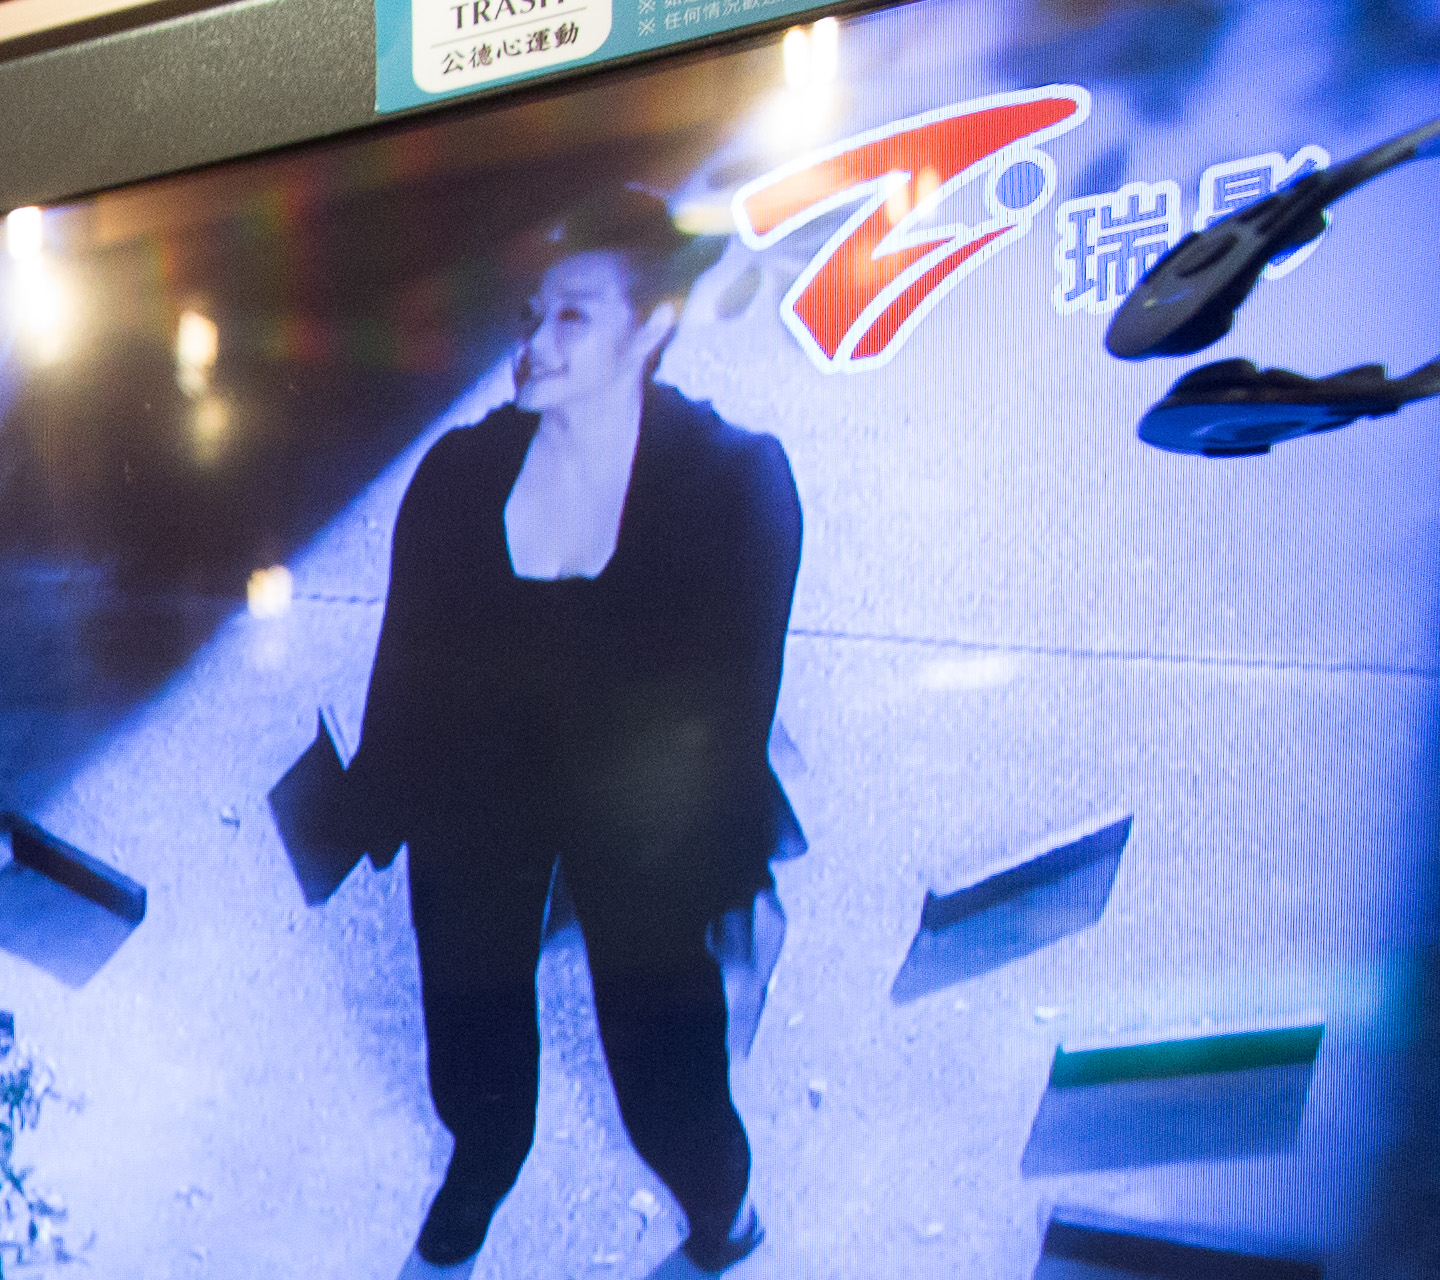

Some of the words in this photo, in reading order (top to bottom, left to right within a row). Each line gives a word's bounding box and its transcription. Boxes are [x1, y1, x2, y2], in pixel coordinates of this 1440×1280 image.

[441, 22, 580, 75] 公德心運動
